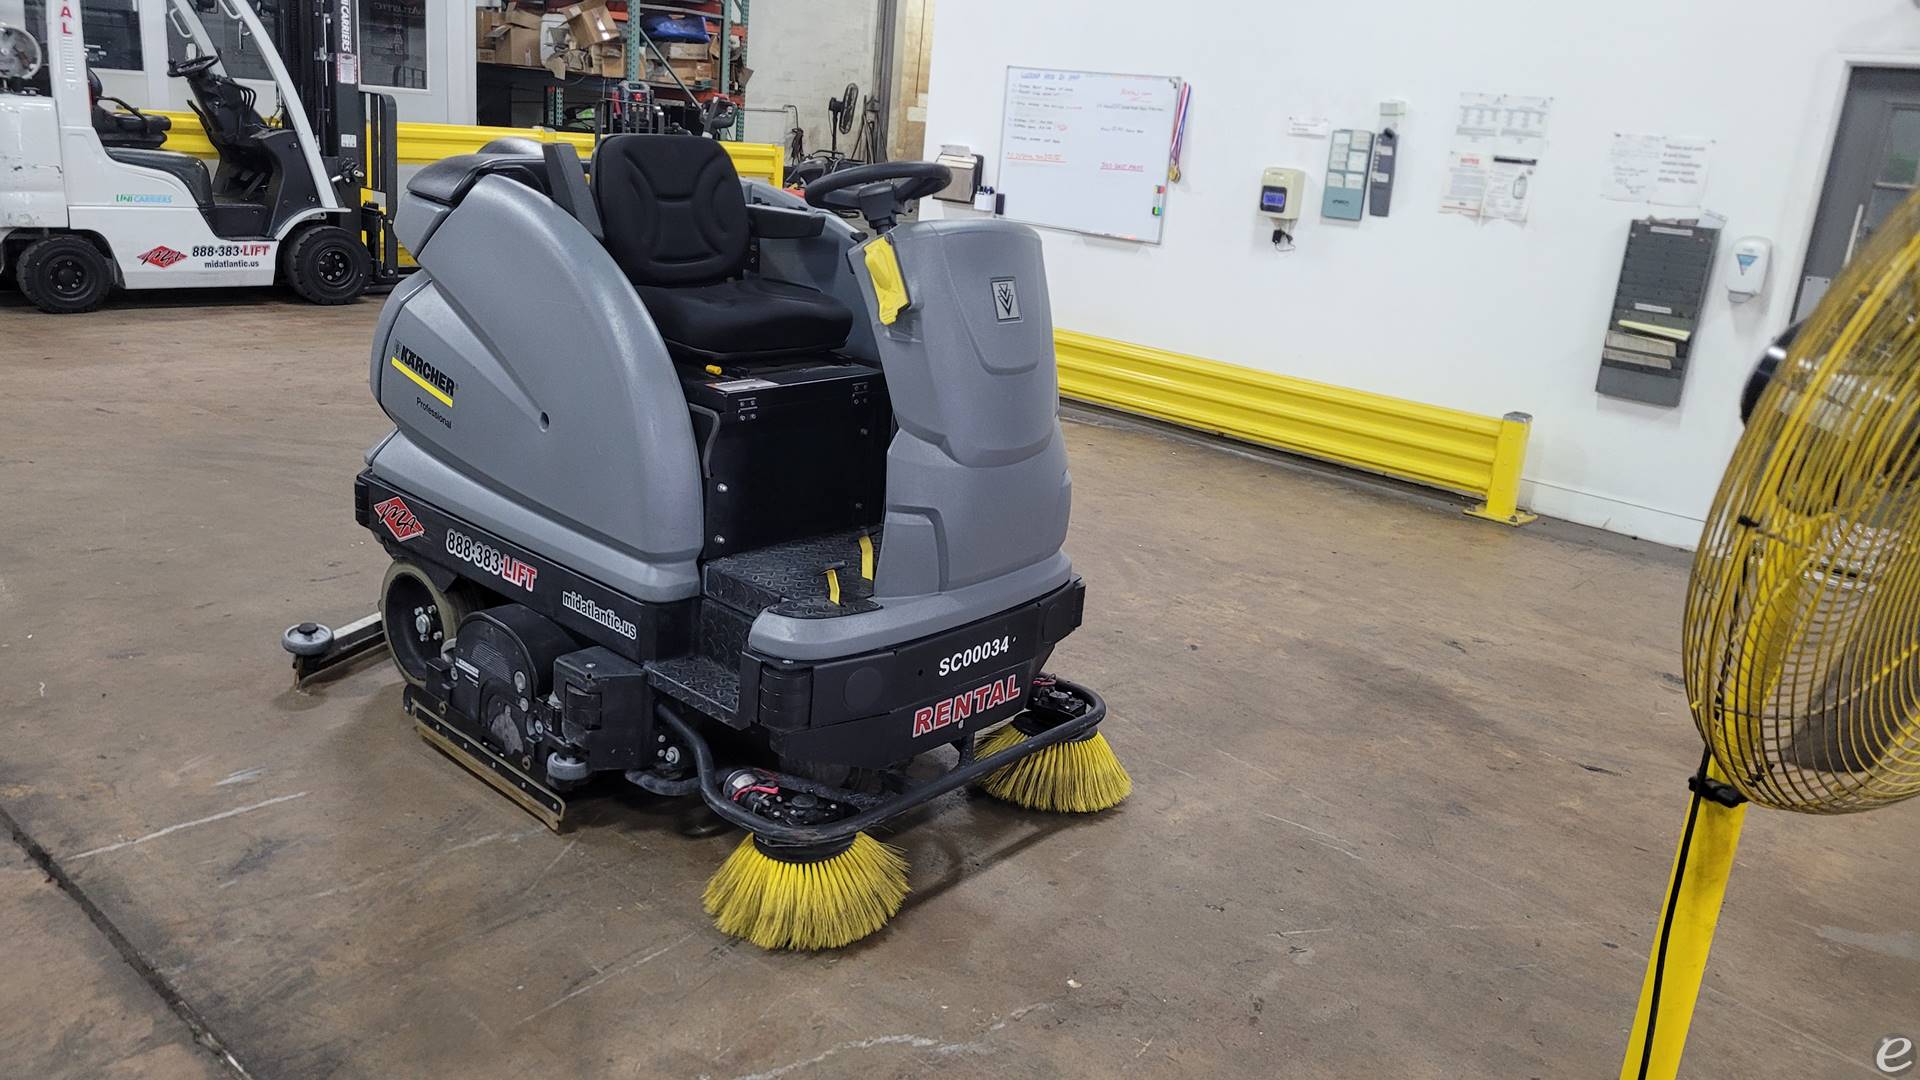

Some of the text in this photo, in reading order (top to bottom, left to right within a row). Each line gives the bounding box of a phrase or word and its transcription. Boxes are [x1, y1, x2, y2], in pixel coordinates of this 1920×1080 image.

[60, 0, 72, 35] AL
[204, 259, 260, 269] midatlantic.us
[400, 345, 456, 398] KÄRCHER
[416, 396, 453, 430] Professional
[562, 590, 637, 640] midatlantic.us
[938, 635, 1009, 677] SC00034
[912, 674, 1021, 738] RENTAL
